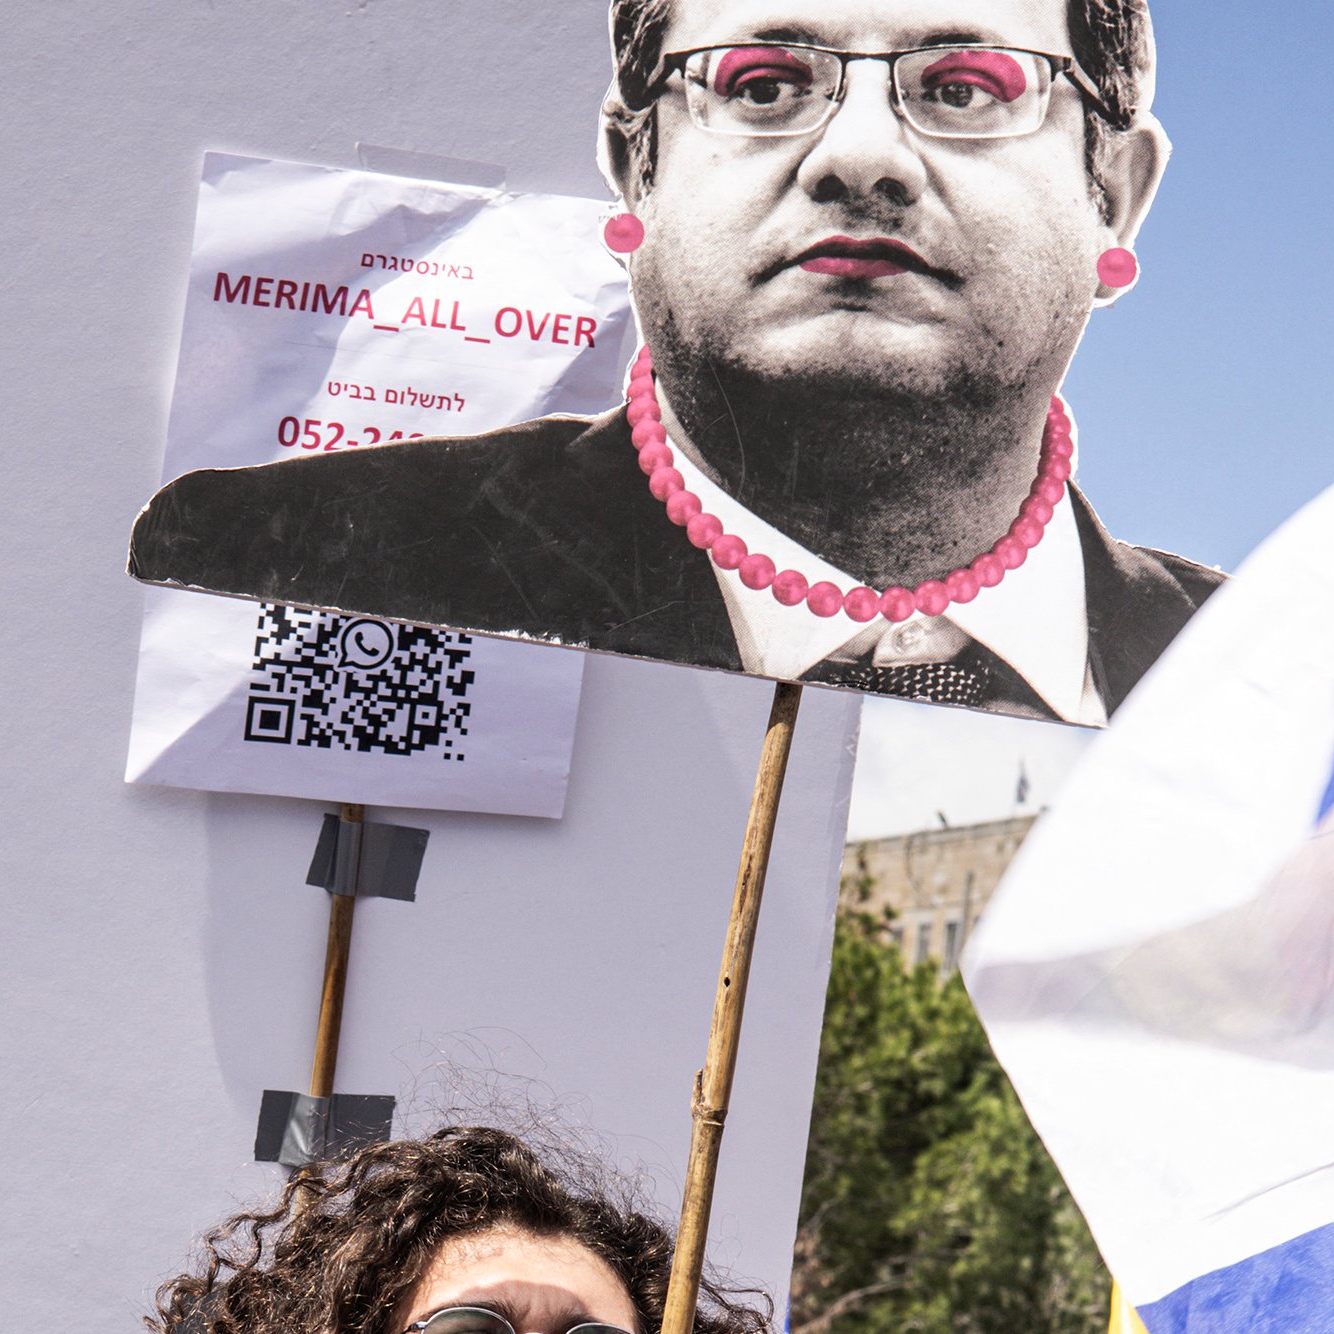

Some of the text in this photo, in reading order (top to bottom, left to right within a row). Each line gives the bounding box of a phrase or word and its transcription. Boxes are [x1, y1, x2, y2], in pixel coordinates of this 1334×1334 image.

[360, 252, 474, 281] באינסטגרם
[213, 271, 598, 348] MERIMA_ALL_OVER
[327, 380, 466, 413] לתשלום בביט
[277, 415, 424, 452] 052-2
